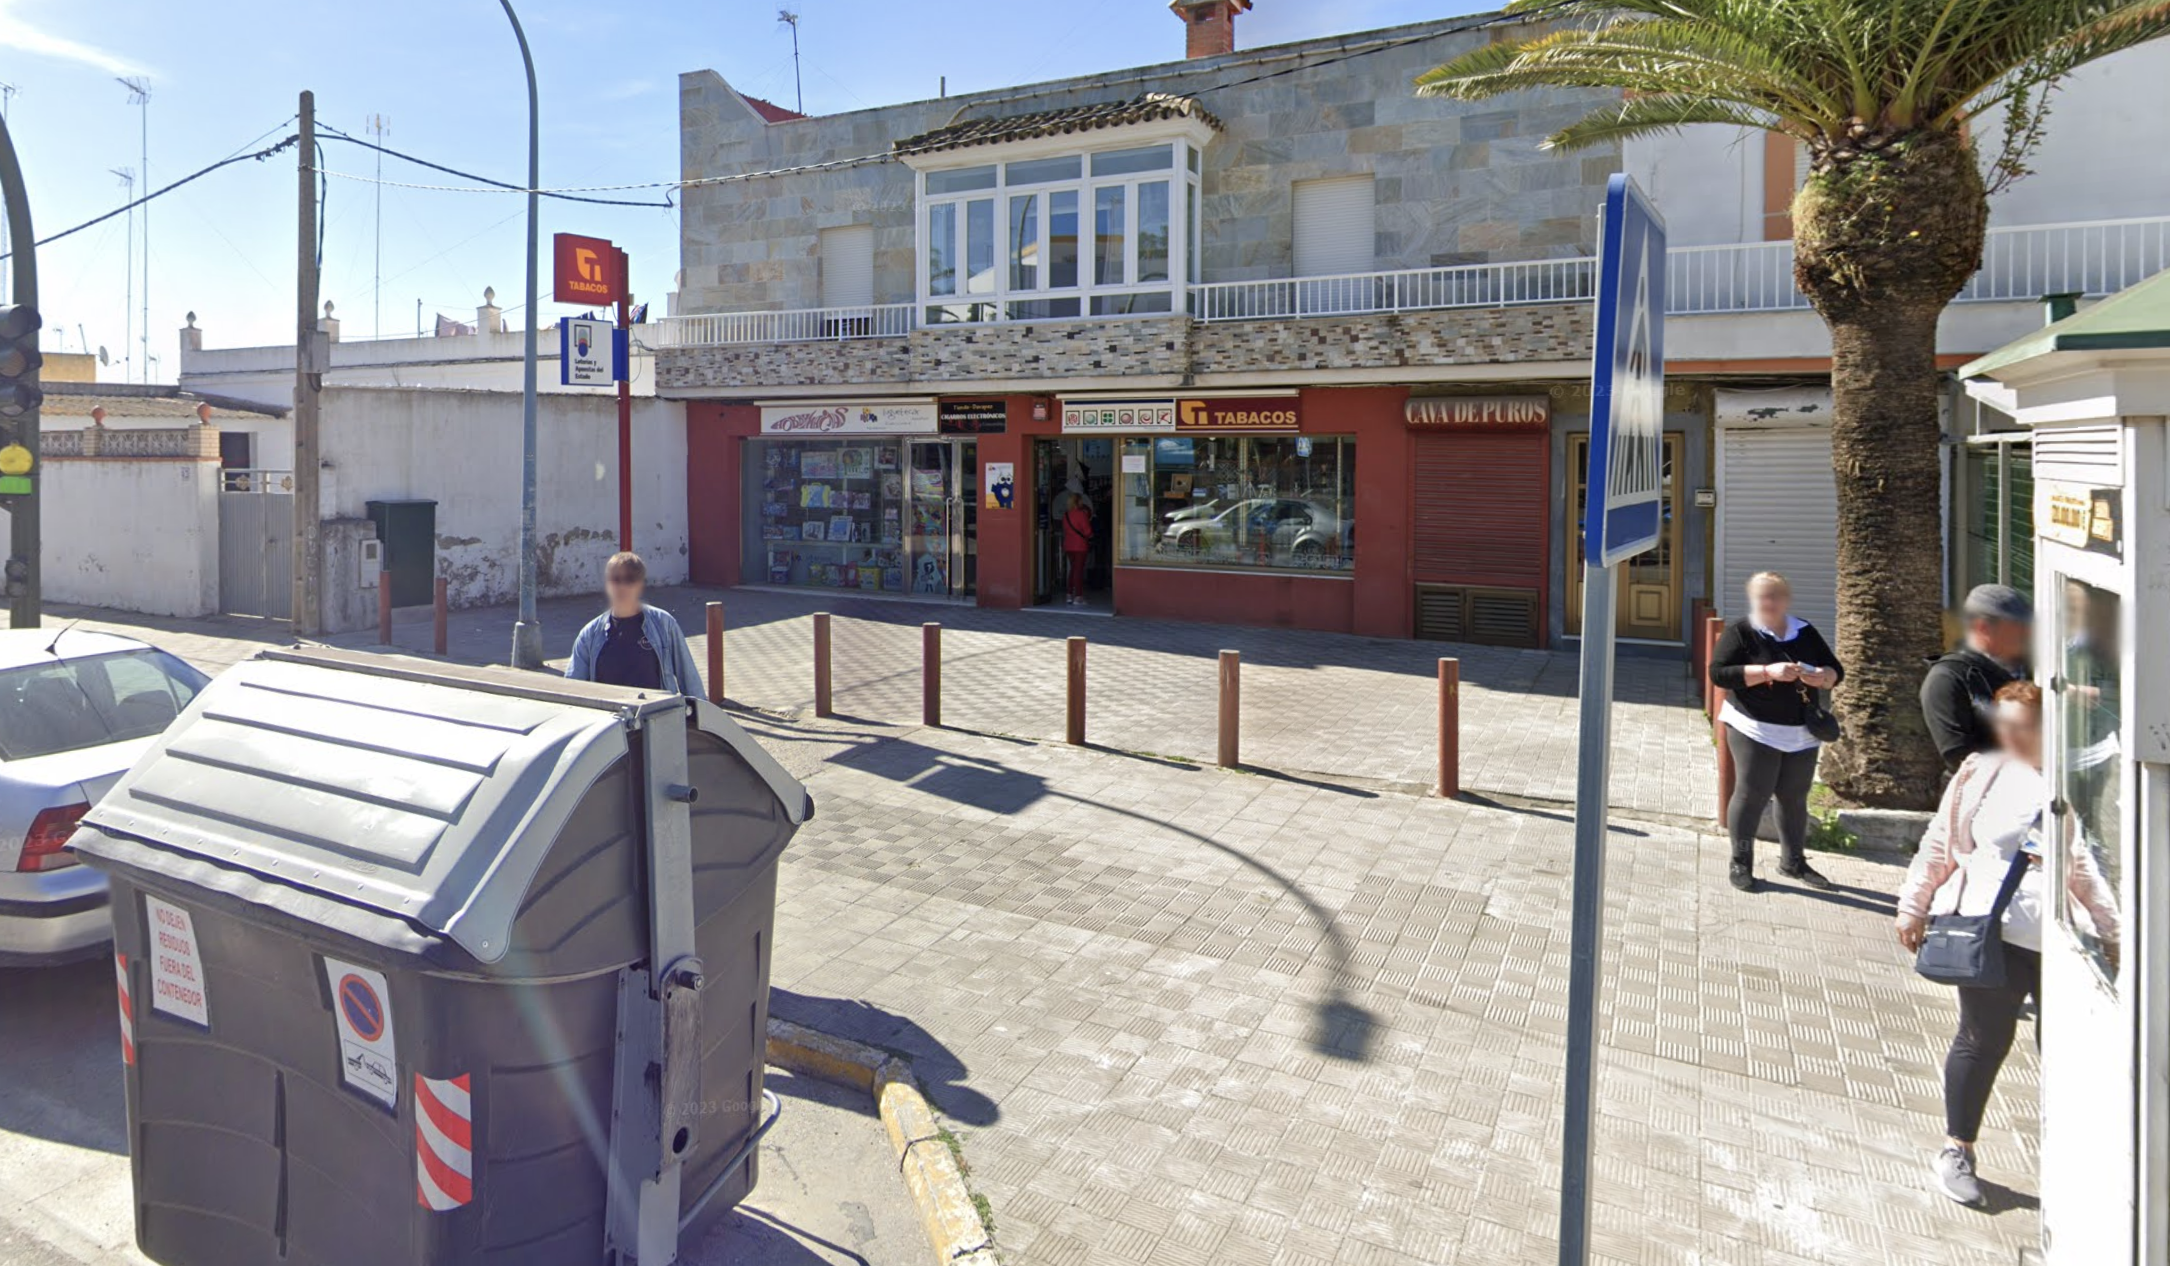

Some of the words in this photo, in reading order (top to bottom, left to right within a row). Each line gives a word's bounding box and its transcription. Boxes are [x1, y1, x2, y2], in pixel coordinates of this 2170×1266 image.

[569, 281, 608, 294] TABACOS
[967, 411, 1006, 420] ELECTRÓNICOS
[1214, 411, 1297, 424] TABACOS
[1405, 401, 1449, 423] CAVA
[1454, 401, 1479, 423] DE
[1482, 400, 1547, 423] PUROS
[156, 908, 165, 925] NO
[165, 910, 187, 932] DEJEN
[159, 931, 191, 956] RESIDUOS
[160, 955, 182, 978] FUERA
[182, 963, 196, 982] DEL
[157, 979, 203, 1007] CONTENEDOR
